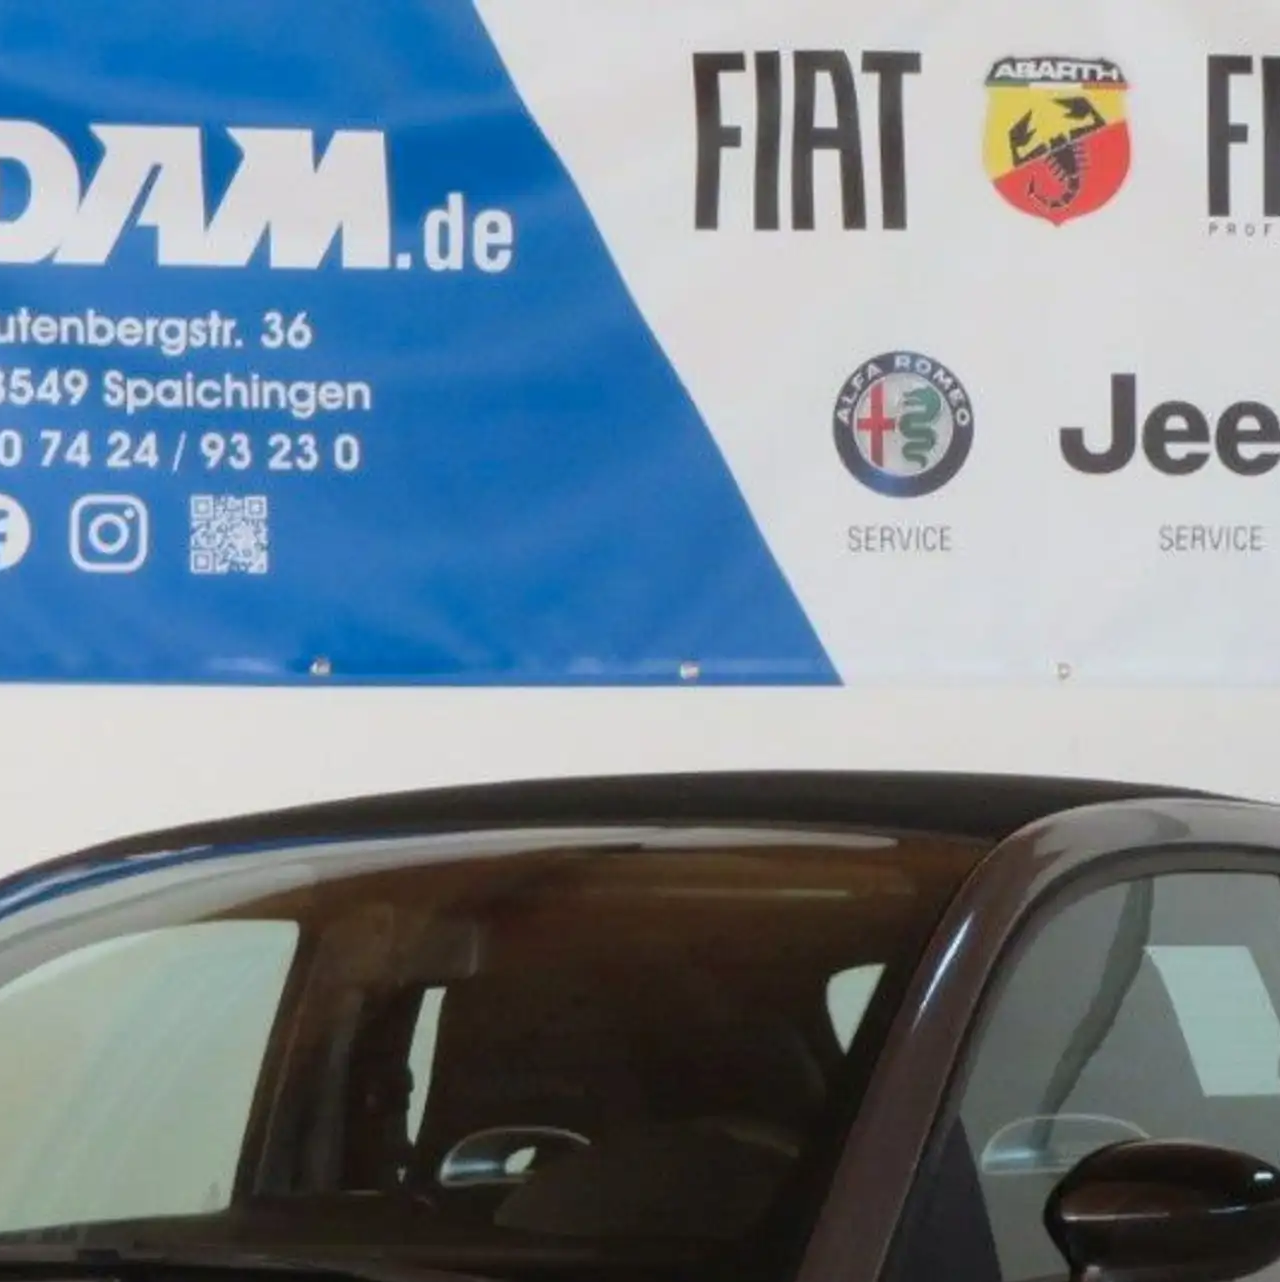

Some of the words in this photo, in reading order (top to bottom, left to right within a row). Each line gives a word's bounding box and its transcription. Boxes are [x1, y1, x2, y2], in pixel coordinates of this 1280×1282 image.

[994, 60, 1119, 81] ABARTH
[693, 50, 922, 231] FIAT
[260, 311, 313, 350] 36
[103, 370, 371, 419] Spaichingen
[836, 361, 883, 426] ALFA
[893, 354, 971, 427] ROMEO
[40, 429, 91, 468] 74
[106, 430, 159, 469] 24
[199, 432, 252, 470] 93
[268, 433, 319, 471] 23
[334, 433, 361, 471] 0
[847, 525, 952, 553] SERVICE
[1158, 524, 1264, 552] SERVICE
